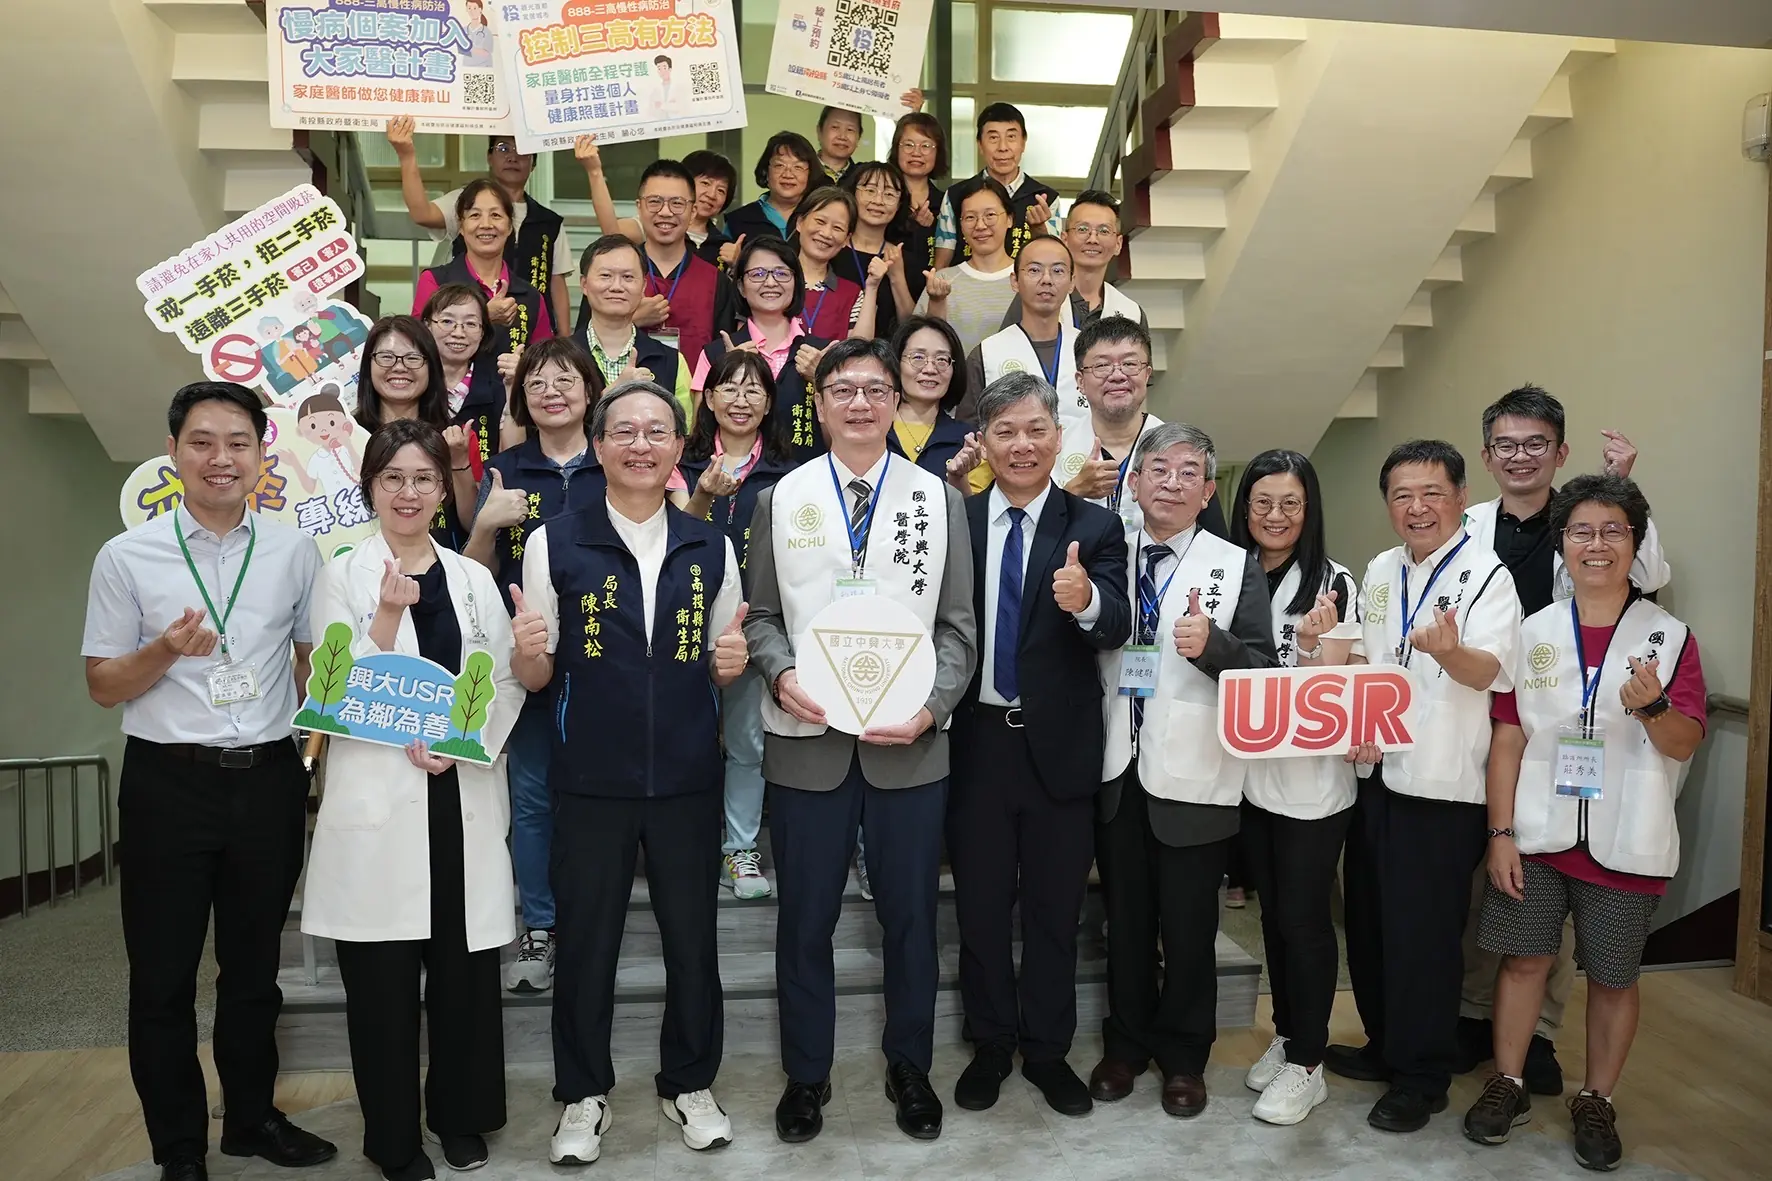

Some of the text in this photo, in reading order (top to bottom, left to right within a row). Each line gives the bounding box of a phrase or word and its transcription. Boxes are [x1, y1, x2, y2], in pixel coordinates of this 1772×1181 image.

[282, 10, 471, 50] 慢病個案加入
[568, 1, 670, 17] 888-三高慢性病防治
[521, 17, 716, 62] 控制三高有方法
[303, 45, 454, 81] 大家醫計畫
[525, 61, 649, 88] 家庭醫師全程守護
[292, 83, 450, 104] 家庭醫師做您健康靠山
[544, 82, 637, 106] 量身打造個人
[547, 99, 640, 124] 健康照護計畫
[145, 189, 316, 294] 請避免在家人共用的空間吸菸
[155, 206, 337, 323] 戒一手菸，拒二手菸
[184, 272, 289, 344] 遠離三手菸
[791, 404, 804, 446] 衛生局
[804, 382, 815, 447] 南投縣政府
[528, 492, 541, 519] 科長
[787, 535, 826, 549] NCHU
[893, 512, 911, 565] 醫學院
[910, 490, 930, 596] 國立中興大學
[602, 575, 618, 610] 局長
[1205, 568, 1226, 627] 國立中
[581, 592, 603, 659] 陳南松
[674, 608, 691, 663] 衛生局
[690, 577, 705, 662] 南投縣政府
[830, 635, 905, 650] 國立中興大學
[1277, 623, 1296, 667] 醫學
[347, 665, 455, 707] 興大USR
[856, 697, 873, 705] 1919
[1523, 676, 1559, 690] NCHU
[338, 695, 451, 740] 為鄰為善
[1224, 672, 1413, 753] USR
